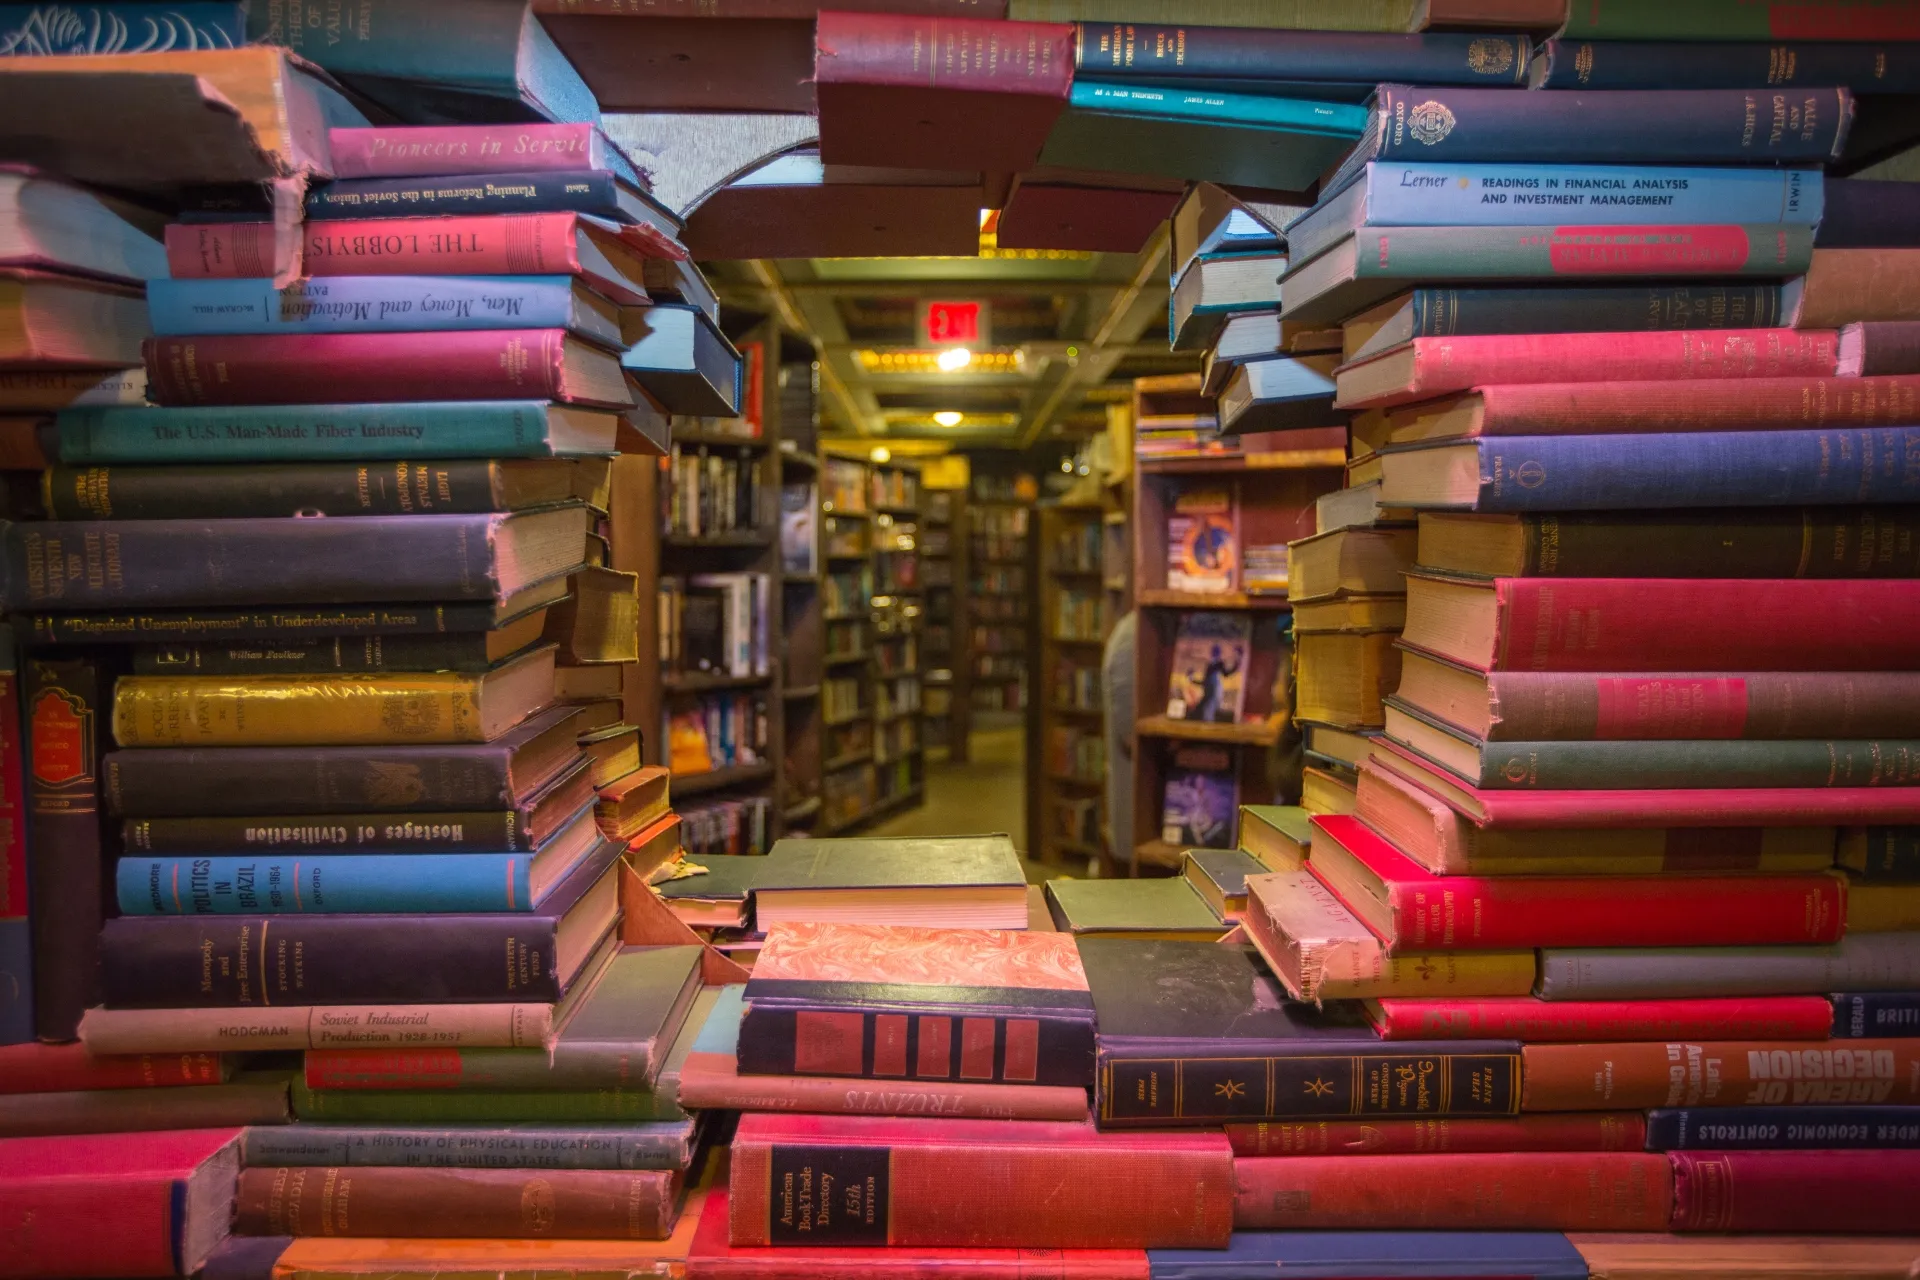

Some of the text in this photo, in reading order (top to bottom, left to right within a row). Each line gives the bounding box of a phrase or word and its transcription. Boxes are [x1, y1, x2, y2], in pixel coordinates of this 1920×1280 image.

[308, 7, 322, 28] OF
[1100, 35, 1109, 53] THE
[1113, 25, 1122, 67] MICHIGAN
[1125, 46, 1134, 68] POOR
[1156, 32, 1165, 59] BRUCE
[1114, 91, 1129, 99] MAN
[1394, 101, 1404, 147] OXFORD
[1771, 94, 1784, 147] CAPITAL
[1791, 105, 1799, 130] AND
[1803, 96, 1816, 142] VALUE
[369, 138, 467, 158] Pioneers
[481, 135, 503, 153] in
[423, 188, 436, 199] in
[438, 186, 485, 199] Reforms
[486, 185, 537, 197] Planning
[1400, 170, 1448, 189] Lerner
[1482, 178, 1689, 190] READINGS IN FINANCIAL ANALYSIS
[1789, 171, 1800, 213] IRWIN
[323, 191, 362, 205] Union,
[368, 190, 400, 203] Soviet
[401, 188, 420, 201] the
[1481, 193, 1674, 207] AND INVESTMENT MANAGEMENT
[304, 233, 484, 257] THE LOBBYIS
[279, 286, 329, 297] PATTON
[281, 294, 525, 322] Men, Money and Motivation
[1697, 299, 1707, 316] OF
[1731, 294, 1745, 323] THE
[1850, 391, 1860, 415] ASIA
[153, 422, 425, 441] The U.S. Man-Made Fiber Industry
[75, 475, 88, 509] PRESS
[357, 467, 371, 508] MULLER
[415, 465, 433, 509] METALS
[436, 471, 451, 502] LIGHT
[1834, 524, 1844, 562] HAZEN
[47, 540, 65, 598] SEVENTH
[68, 552, 84, 581] NEW
[253, 615, 268, 628] in
[272, 614, 377, 630] Underdeveloped
[381, 612, 418, 626] Areas
[229, 649, 306, 661] William Faulkner
[152, 694, 165, 737] SOCIAL
[199, 696, 213, 736] JAPAN
[143, 821, 151, 852] BEACON
[245, 823, 464, 843] Hostages of Civilisation
[506, 810, 517, 852] EICHMANN
[196, 859, 212, 914] POLITICS
[215, 880, 231, 896] IN
[240, 863, 256, 908] BRAZIL
[313, 867, 322, 905] OXFORD
[1415, 891, 1424, 903] OF
[1431, 905, 1440, 931] COLOR
[1443, 890, 1455, 945] PHOTOGRAPHY
[202, 937, 216, 993] Monopoly
[219, 955, 230, 977] and
[239, 926, 252, 1003] Free Enterprise
[278, 938, 287, 991] STOCKING
[295, 941, 304, 989] WATKINS
[507, 937, 516, 990] TWENTIETH
[519, 942, 527, 985] CENTURY
[532, 950, 540, 978] FUND
[219, 1026, 289, 1038] HODGMAN
[320, 1011, 429, 1027] Soviet Industrial
[320, 1030, 462, 1043] Production 1928-1951
[1666, 1043, 1681, 1060] in
[1747, 1050, 1895, 1080] DECISION
[1137, 1078, 1146, 1102] PRESS
[1149, 1070, 1158, 1109] MOHAWK
[1371, 1070, 1379, 1105] OF PERU
[1381, 1061, 1389, 1111] CONQUEROR
[1398, 1062, 1417, 1108] Pizarro
[1416, 1060, 1435, 1112] Incredible
[1470, 1070, 1480, 1101] SHAY
[1483, 1066, 1493, 1105] FRANK
[1594, 1071, 1603, 1092] Hall
[1604, 1060, 1613, 1100] Prentice
[1706, 1057, 1722, 1099] Latin
[842, 1090, 965, 1116] TRUANTS
[1745, 1080, 1896, 1106] ARENA OF
[356, 1136, 613, 1151] A HISTORY OF PHYSICAL EDUCATION
[1699, 1125, 1779, 1140] CONTROLS
[1787, 1124, 1869, 1140] ECONOMIC
[259, 1144, 330, 1156] Schwendener
[406, 1154, 560, 1166] IN THE UNITED STATES
[635, 1150, 671, 1161] Barnes
[338, 1178, 352, 1230] GRAHAM
[780, 1171, 794, 1226] American
[799, 1166, 813, 1232] Book Trade
[817, 1172, 836, 1226] Directory
[846, 1183, 862, 1219] 15th
[865, 1175, 875, 1225] EDITION
